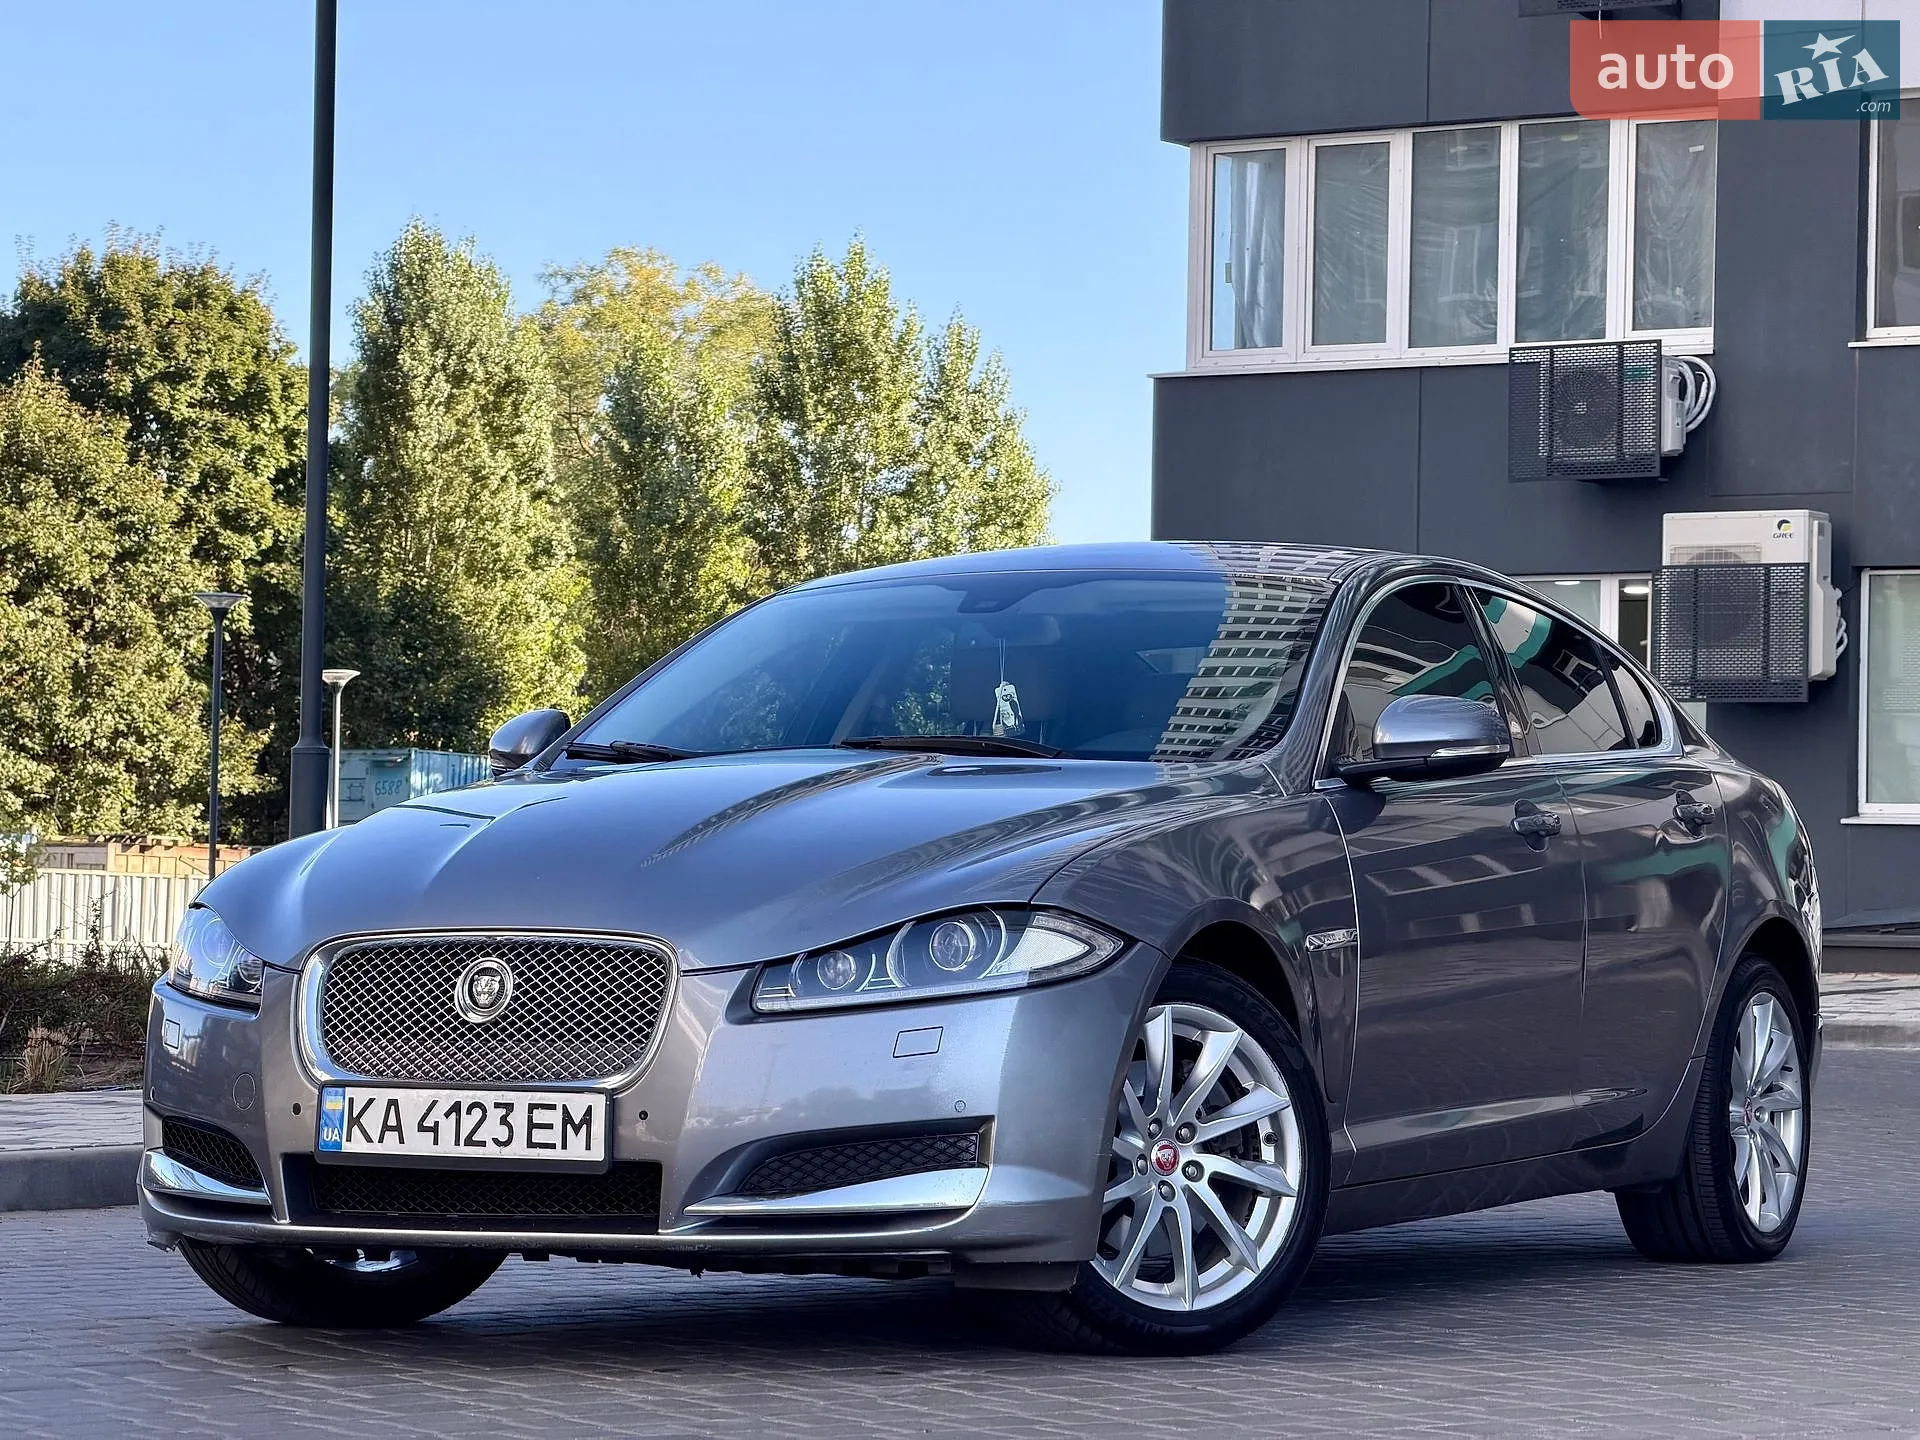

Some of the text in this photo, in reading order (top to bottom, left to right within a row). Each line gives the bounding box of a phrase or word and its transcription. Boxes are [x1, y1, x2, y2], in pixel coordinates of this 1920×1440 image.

[323, 1128, 341, 1142] UA
[345, 1097, 592, 1151] KA 4123 EM
